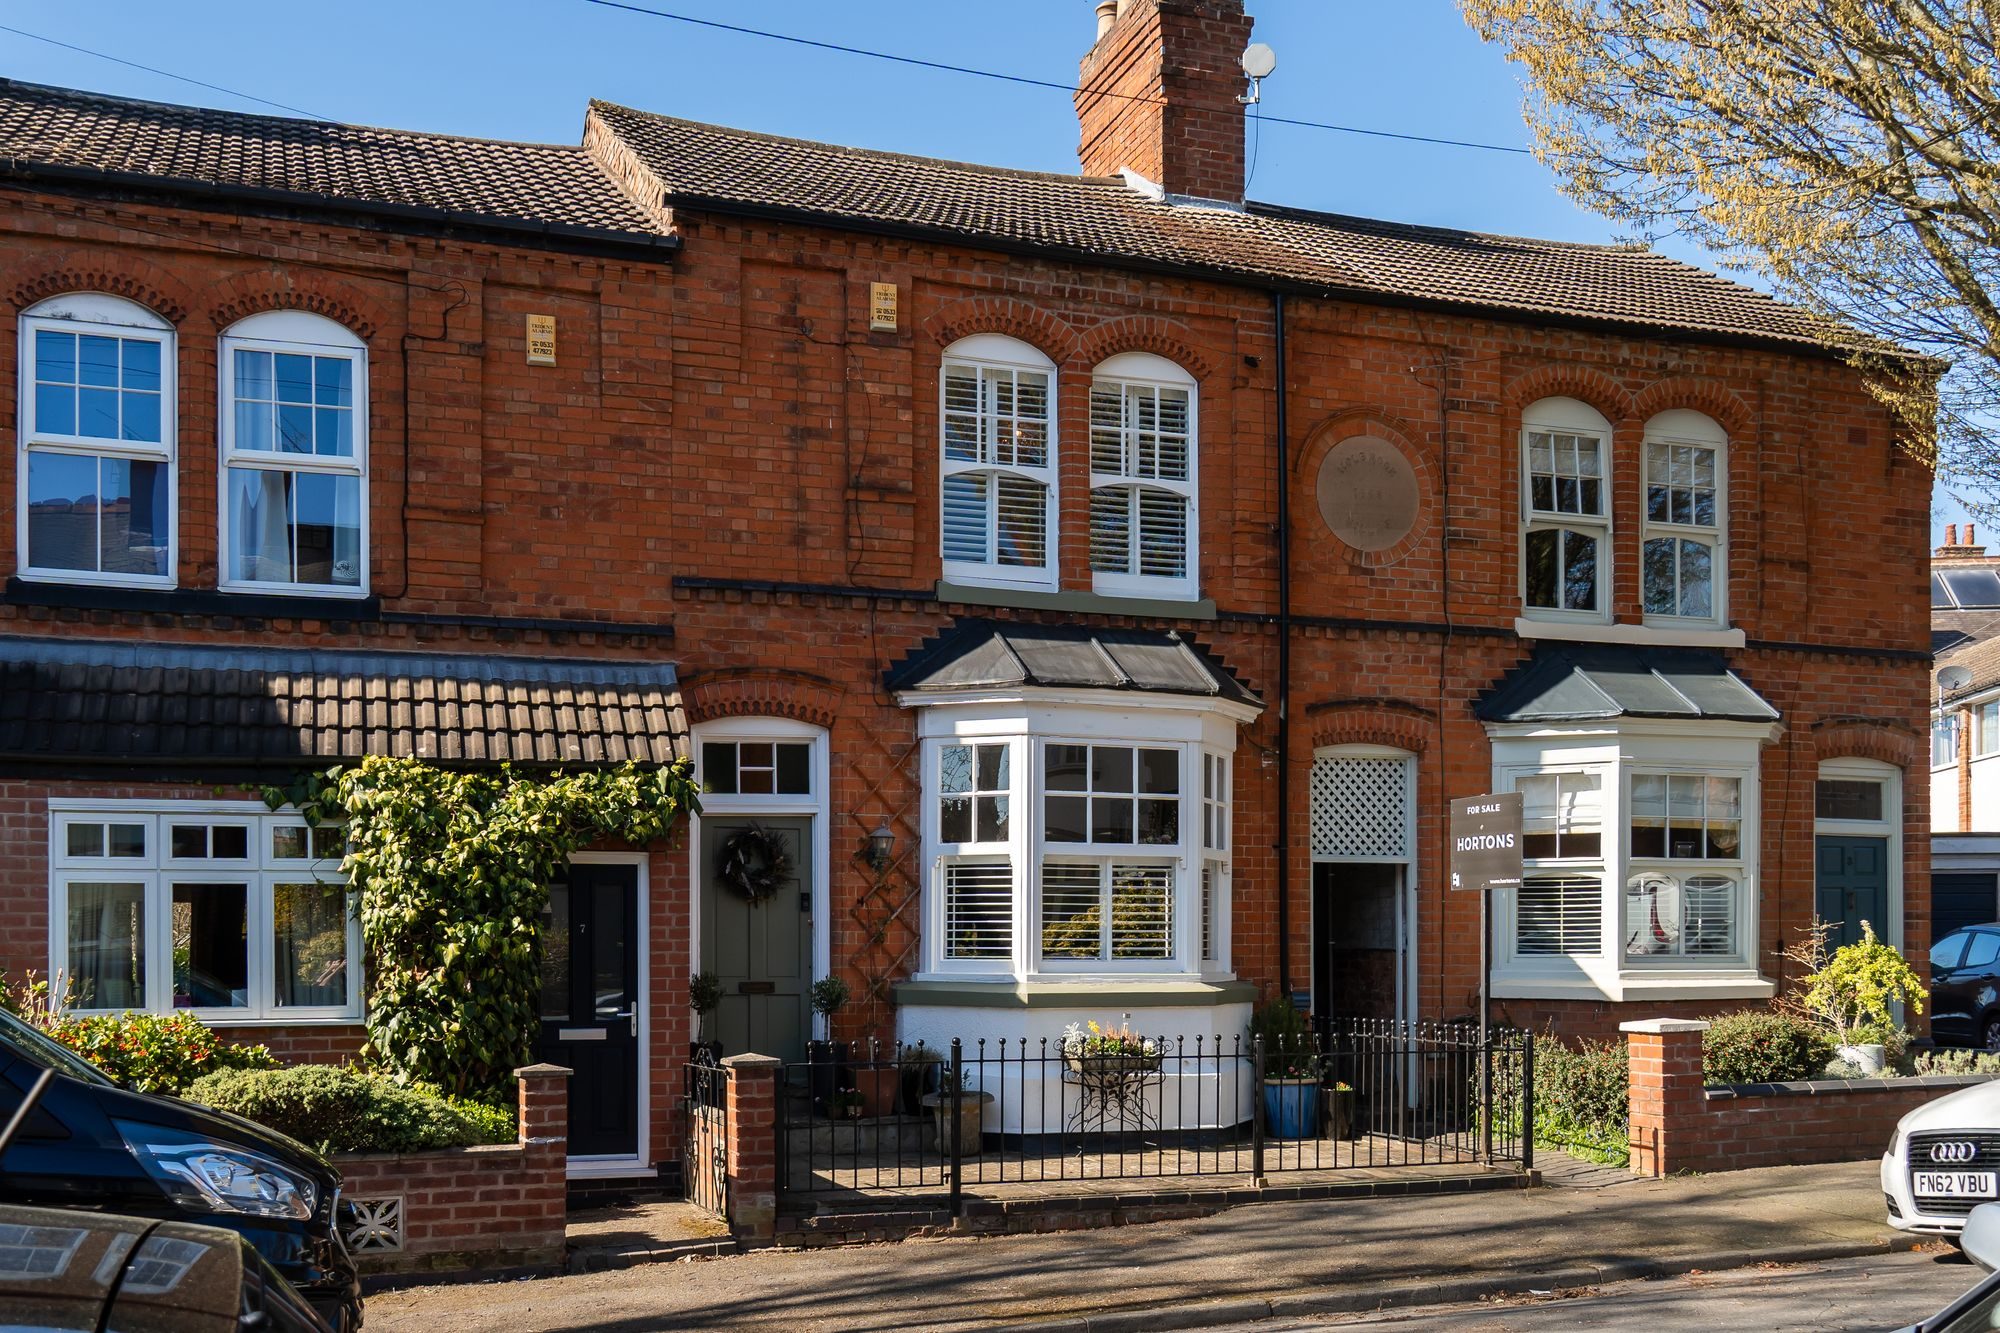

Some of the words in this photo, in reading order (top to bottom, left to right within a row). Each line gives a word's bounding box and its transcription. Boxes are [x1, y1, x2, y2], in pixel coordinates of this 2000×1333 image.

[883, 308, 896, 316] 0533
[540, 341, 554, 349] 0533
[532, 347, 553, 356] 477923
[1467, 805, 1480, 815] FOR
[1481, 803, 1501, 813] SALE
[1457, 833, 1515, 852] HORTONS
[580, 924, 586, 933] 7
[1920, 1175, 1953, 1193] FN62
[1957, 1175, 1988, 1193] VBU
